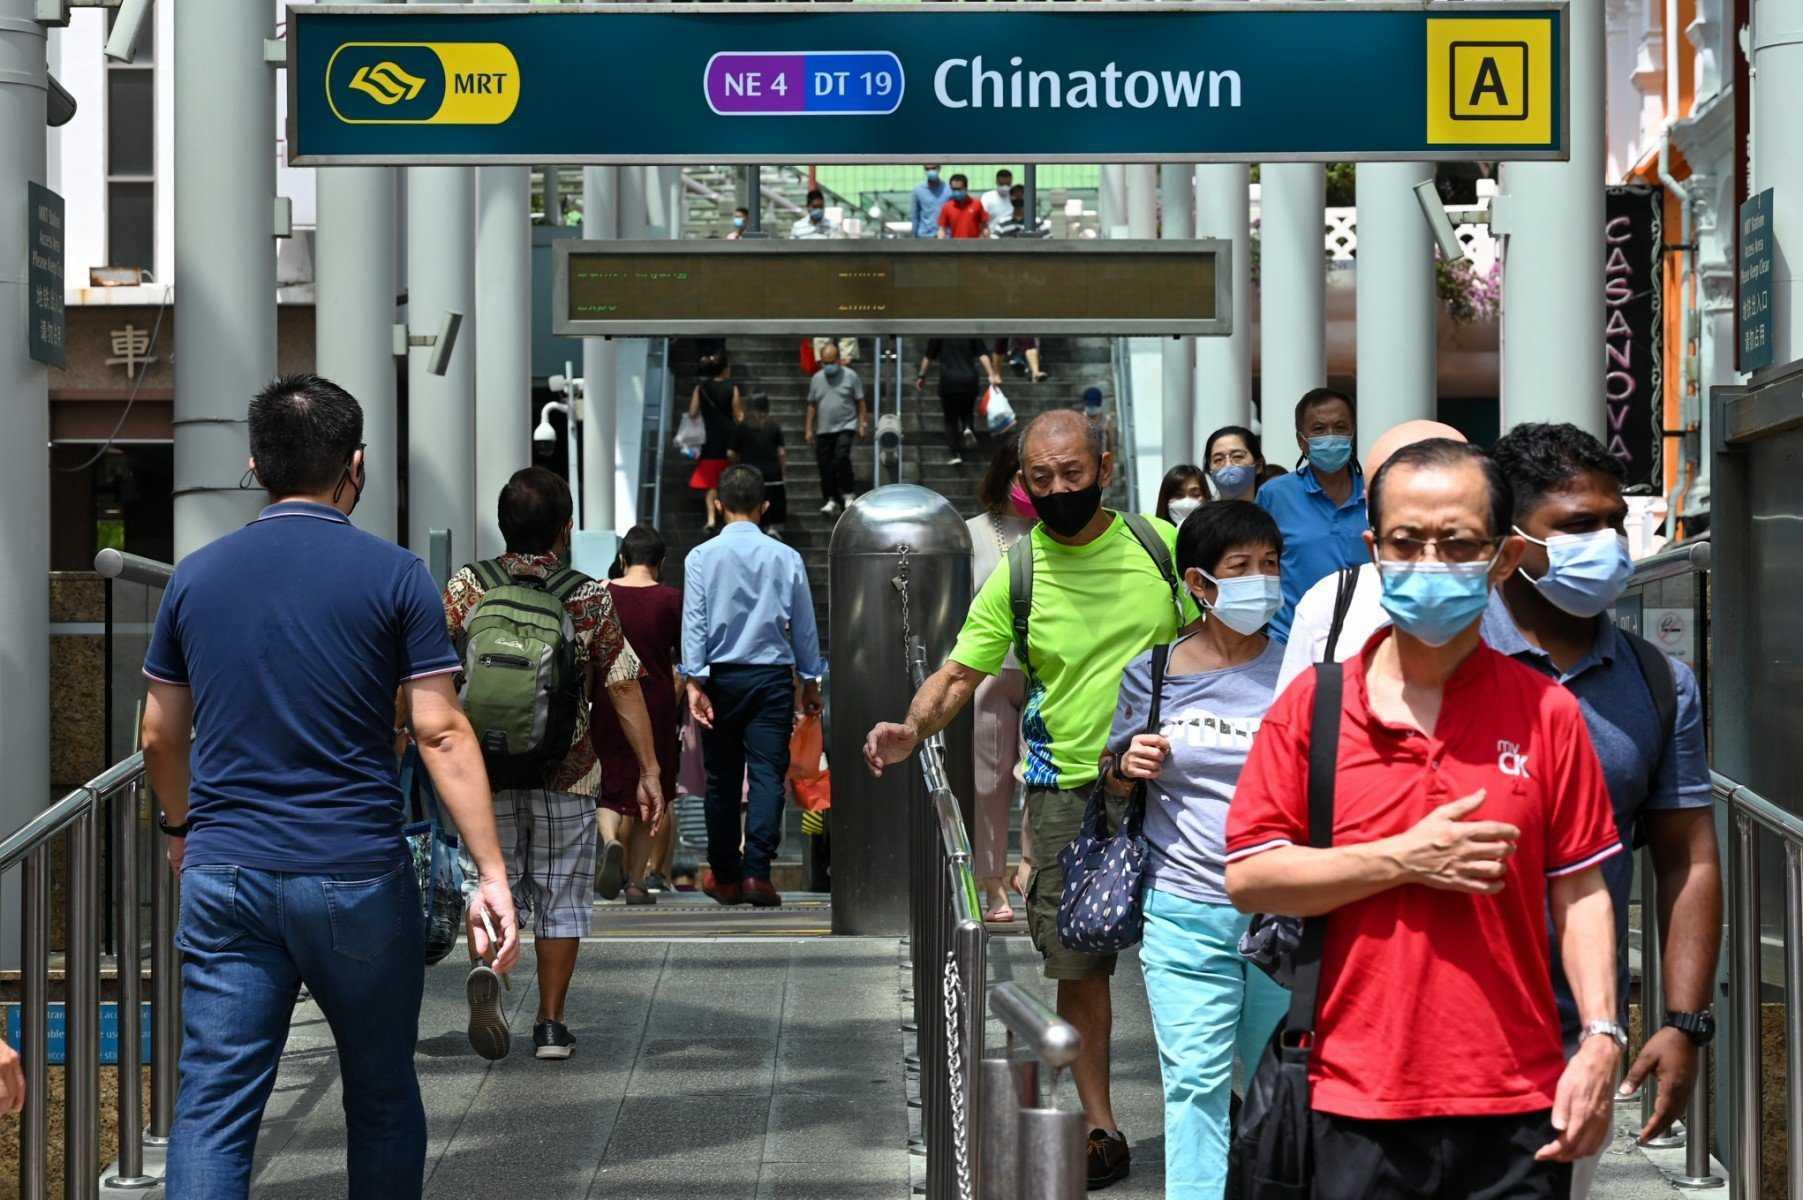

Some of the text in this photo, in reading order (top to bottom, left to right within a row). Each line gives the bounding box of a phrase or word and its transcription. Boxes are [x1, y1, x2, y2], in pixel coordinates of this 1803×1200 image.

[454, 73, 508, 95] MRT
[725, 72, 788, 97] NE 4
[814, 71, 893, 97] DT 19
[933, 55, 1242, 109] Chinatown
[1468, 56, 1509, 106] A
[105, 324, 159, 379] 車
[1605, 216, 1636, 461] CASANOVA
